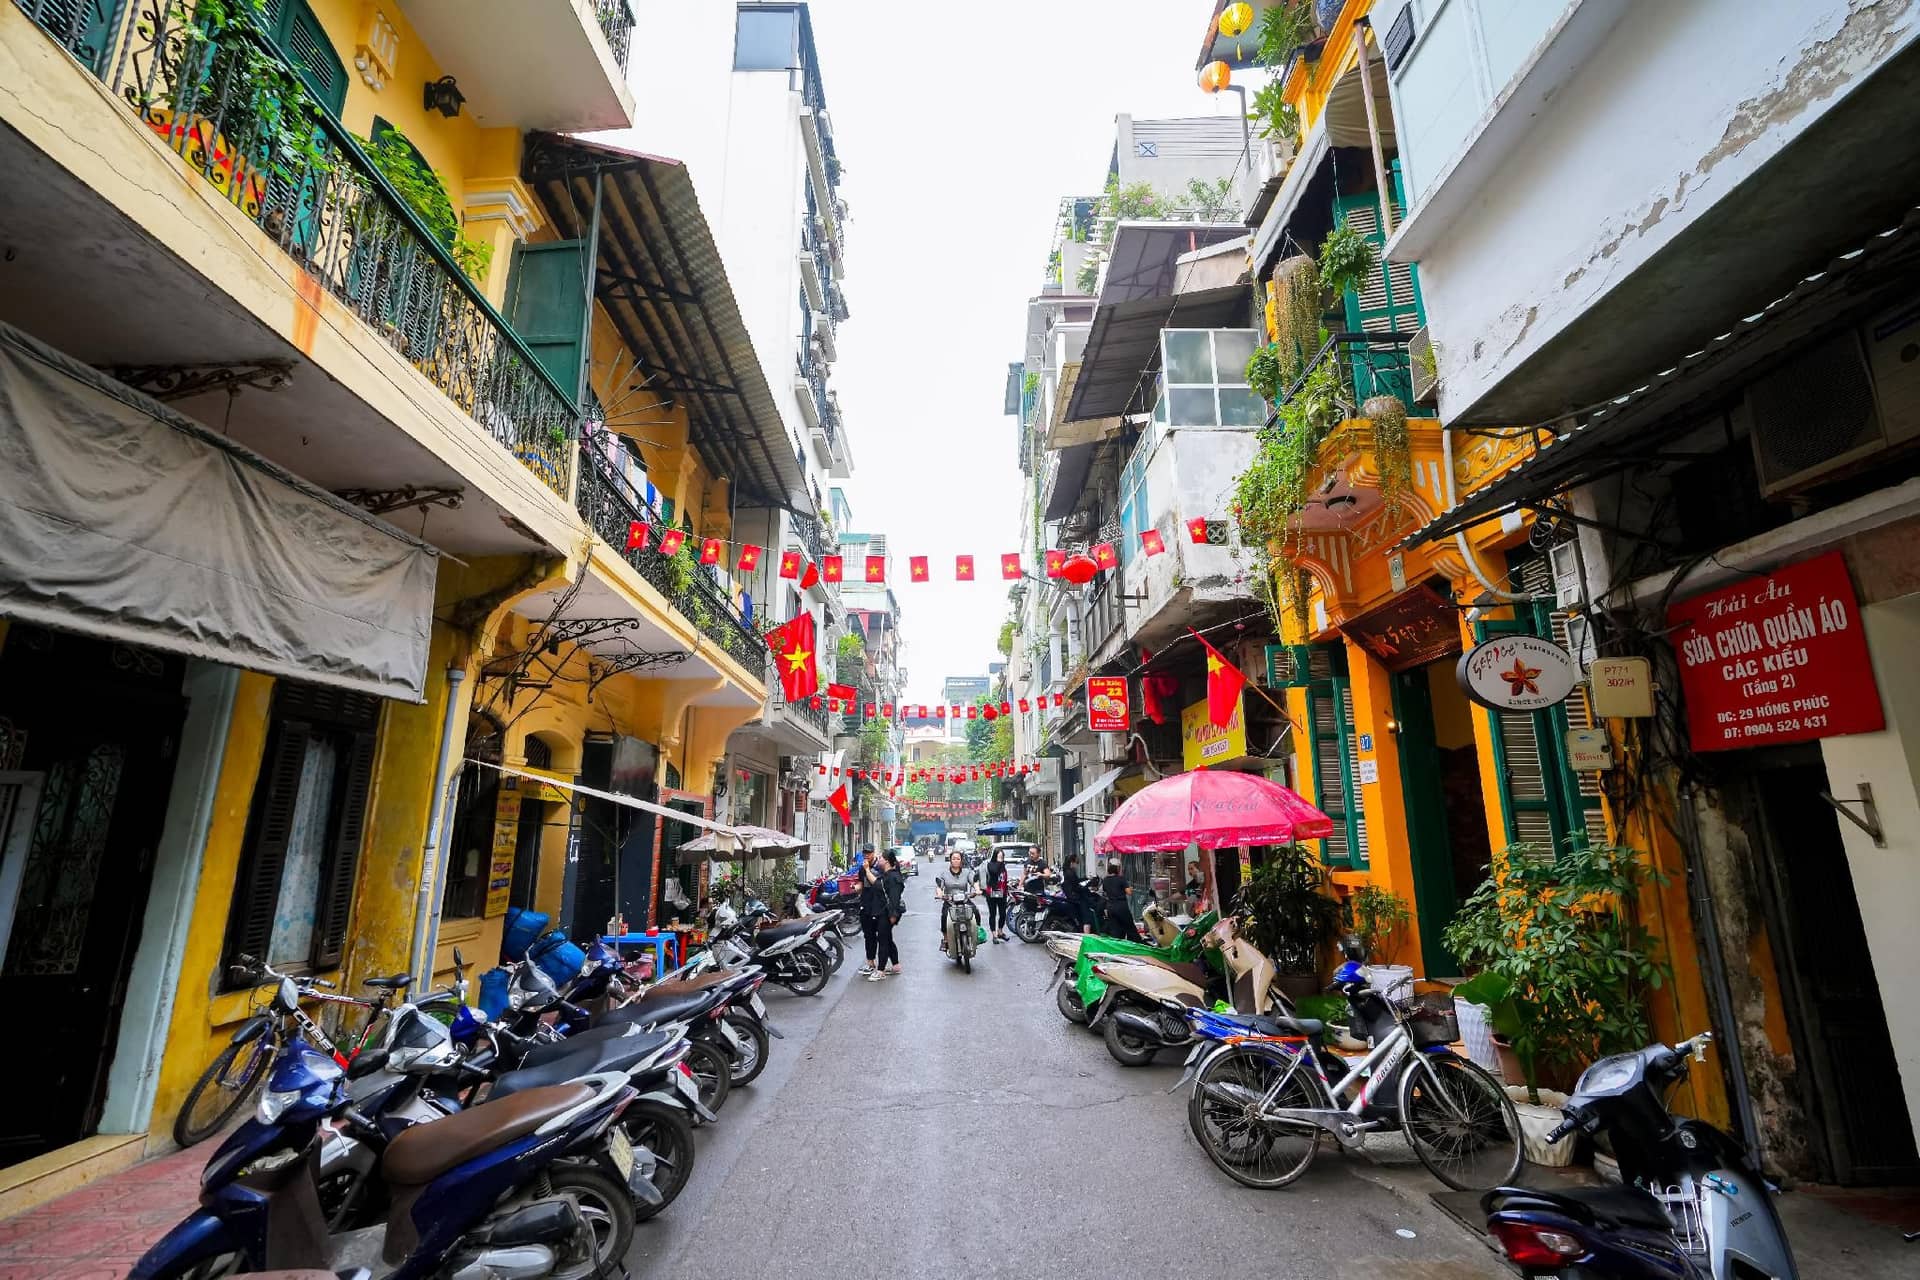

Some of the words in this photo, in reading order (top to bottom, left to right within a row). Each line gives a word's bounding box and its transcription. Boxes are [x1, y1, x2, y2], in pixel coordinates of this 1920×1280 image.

[1754, 579, 1792, 604] Âu
[1683, 628, 1717, 667] SỬA
[1716, 621, 1763, 659] CHỮA
[1763, 602, 1817, 649] QUẦN
[1819, 596, 1848, 634] ÁO
[1722, 658, 1759, 681] CÁC
[1762, 644, 1809, 673] KIỂU
[1107, 687, 1123, 697] 22
[1742, 678, 1778, 698] (Tầng
[1781, 673, 1796, 689] 2)
[1739, 707, 1753, 720] 29
[1793, 695, 1830, 712] PHÚC
[1777, 718, 1800, 733] 524
[1803, 714, 1828, 729] 431
[1360, 736, 1369, 749] 27
[293, 1009, 335, 1053] CUBE
